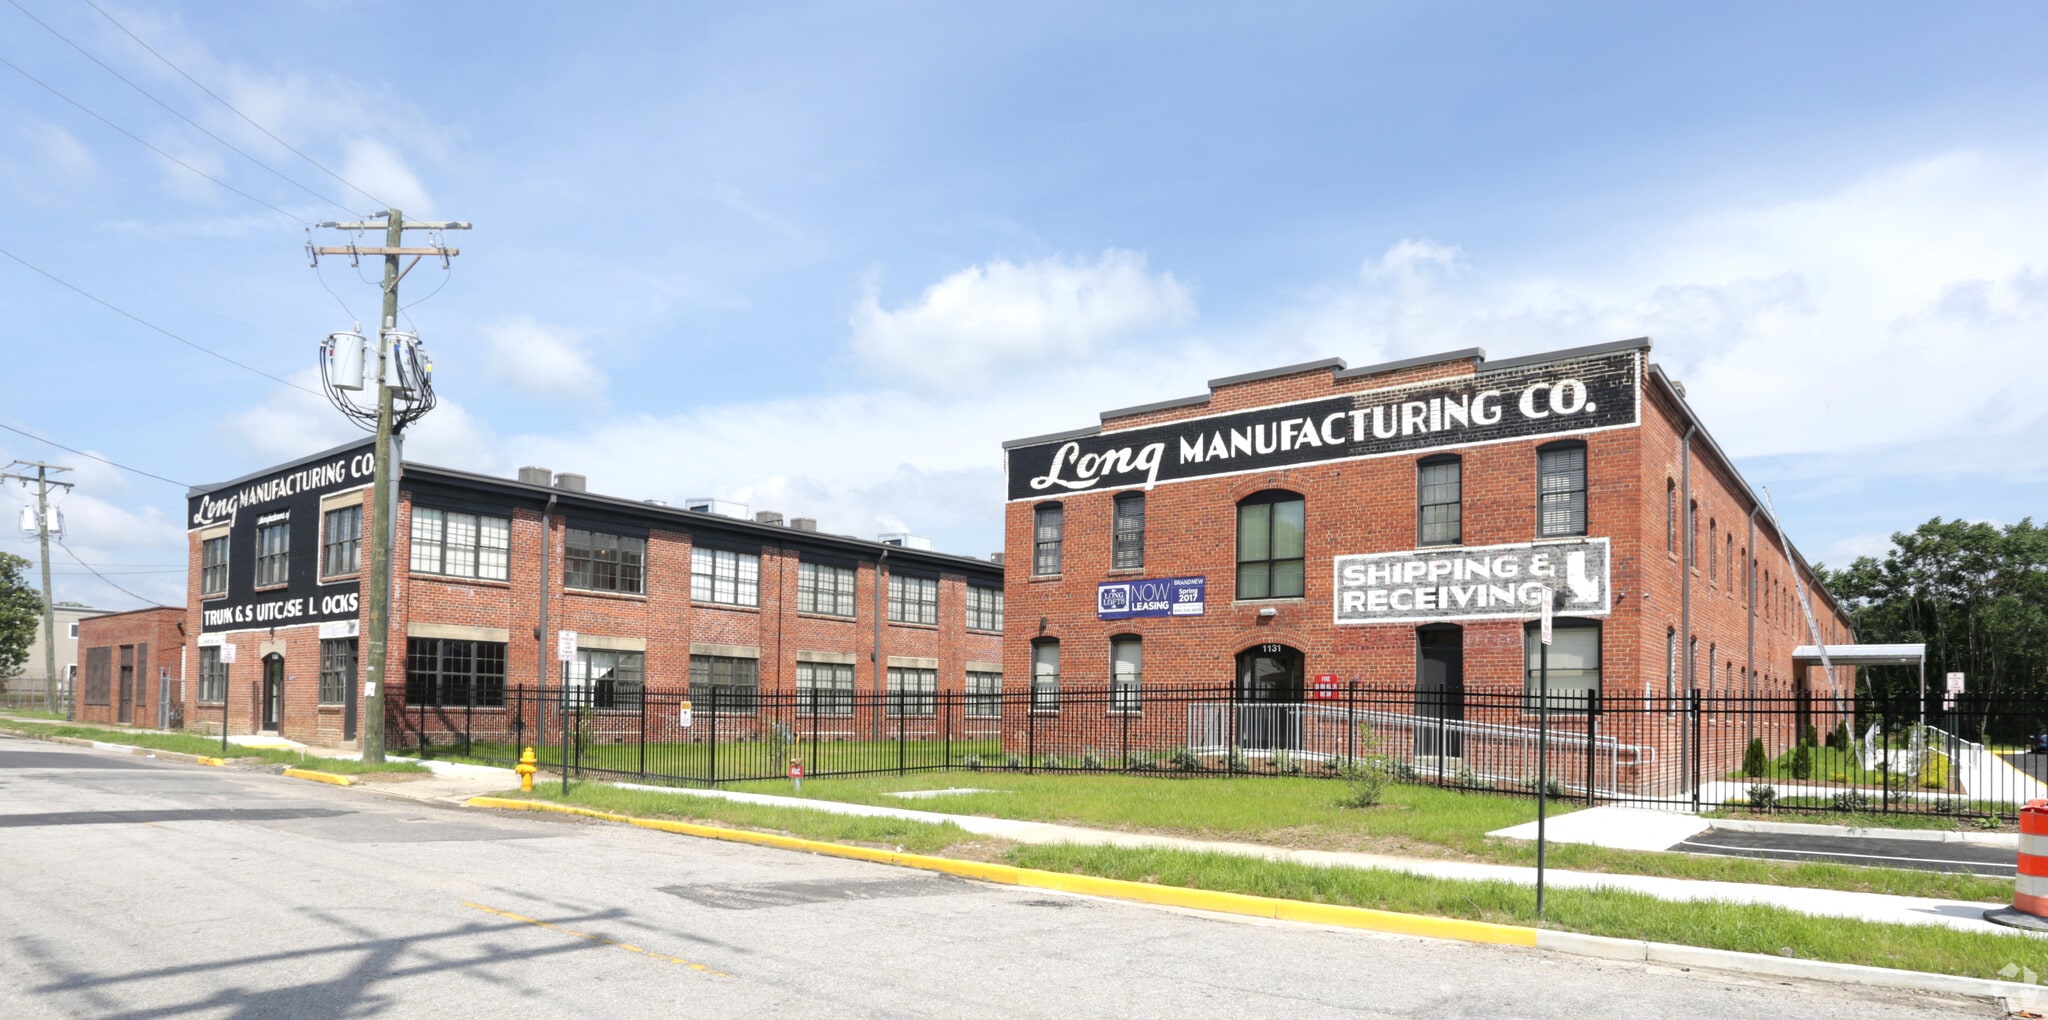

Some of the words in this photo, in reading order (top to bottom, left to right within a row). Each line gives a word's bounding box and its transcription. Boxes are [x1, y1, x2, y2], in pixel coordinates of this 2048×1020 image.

[1030, 441, 1165, 491] Long
[1180, 390, 1501, 465] MANUFACTURING
[1519, 378, 1597, 418] CO.
[193, 494, 239, 528] Long
[239, 460, 346, 509] MANUFACTURING
[1343, 555, 1518, 586] SHIPPING
[1529, 553, 1555, 577] &
[1104, 592, 1124, 600] LONG
[1131, 583, 1170, 602] NOW
[1178, 594, 1198, 602] 2017
[1343, 582, 1542, 613] RECEIVING
[1103, 598, 1125, 606] LOFTS
[1132, 601, 1169, 611] LEASING
[235, 605, 244, 622] &
[1263, 644, 1281, 653] 1131
